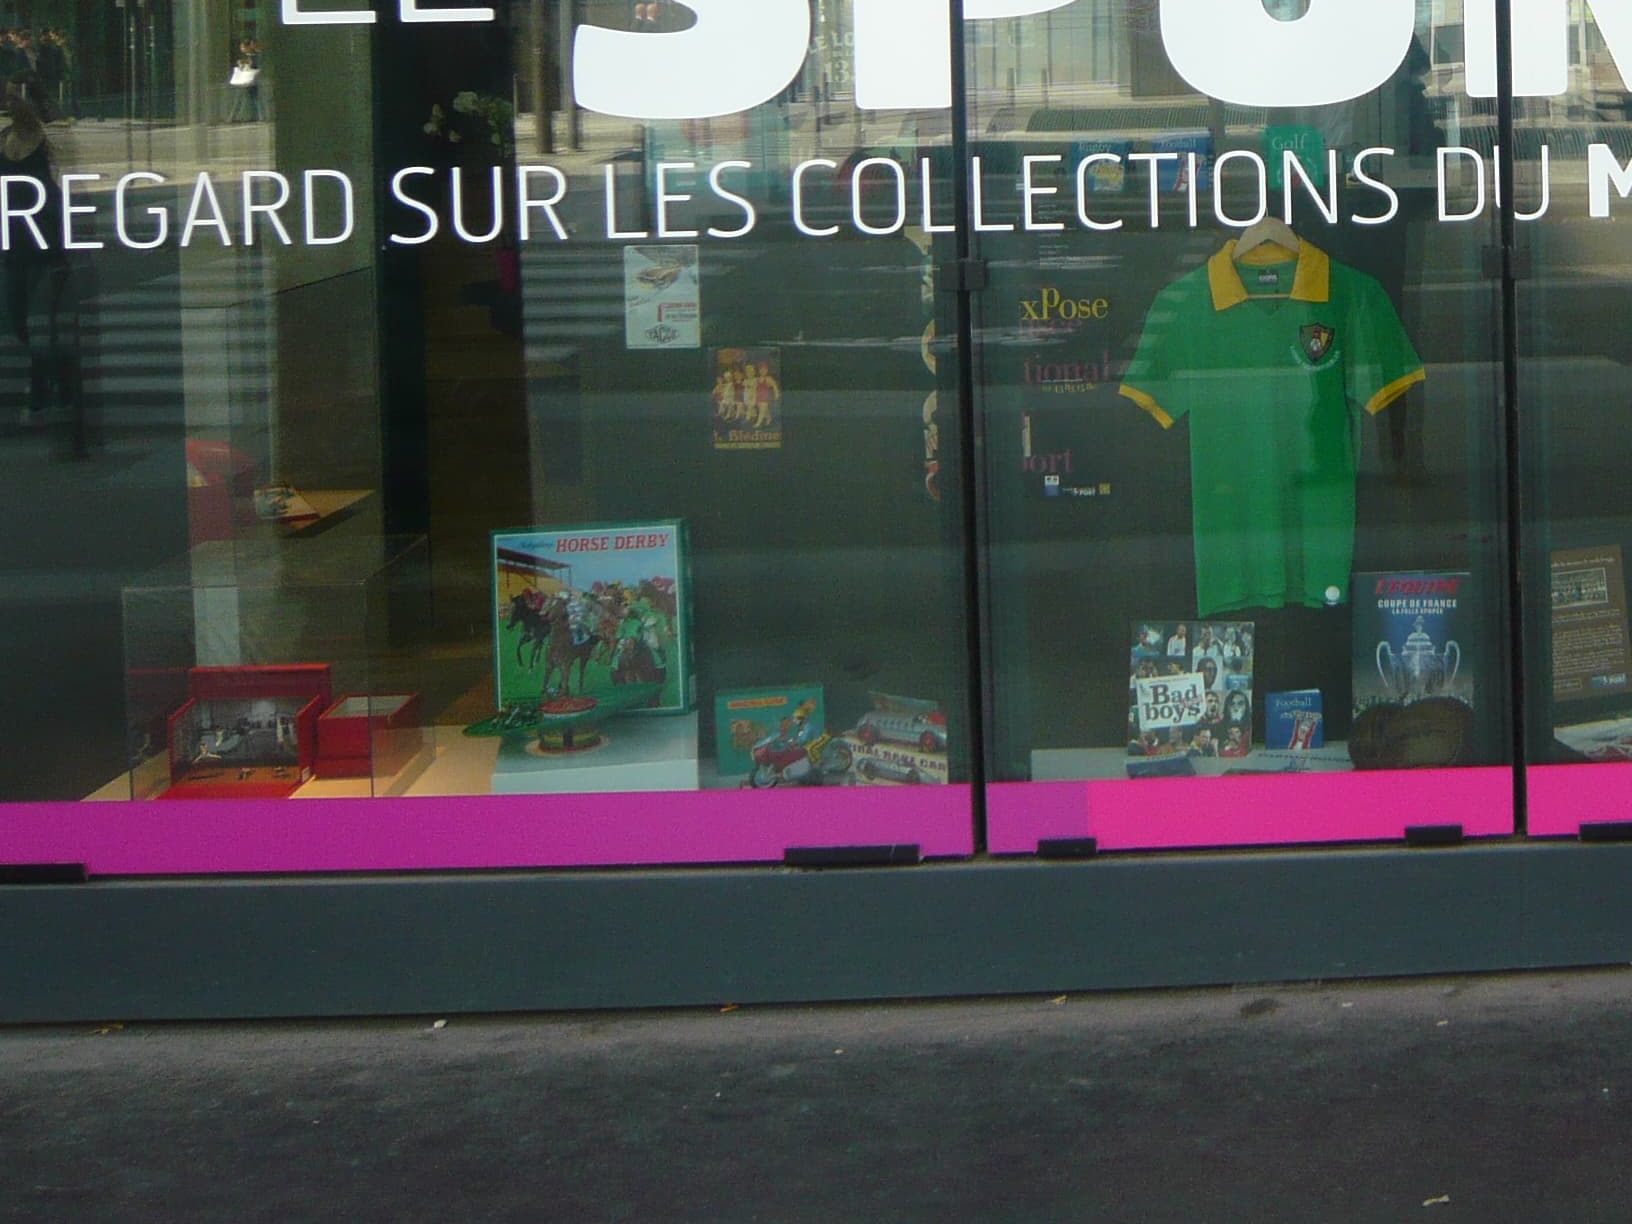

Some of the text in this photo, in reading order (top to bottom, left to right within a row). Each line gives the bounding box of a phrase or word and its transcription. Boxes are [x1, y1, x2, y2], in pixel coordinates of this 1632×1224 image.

[0, 169, 354, 251] REGARD
[390, 165, 569, 244] SUR
[599, 160, 756, 239] LES
[792, 147, 1399, 236] COLLECTIONS
[1436, 144, 1550, 222] DU
[555, 536, 610, 553] HORSE
[613, 532, 670, 551] DERBY
[1377, 599, 1457, 609] COUPE DE FRANCE
[1144, 683, 1201, 724] Bad boys
